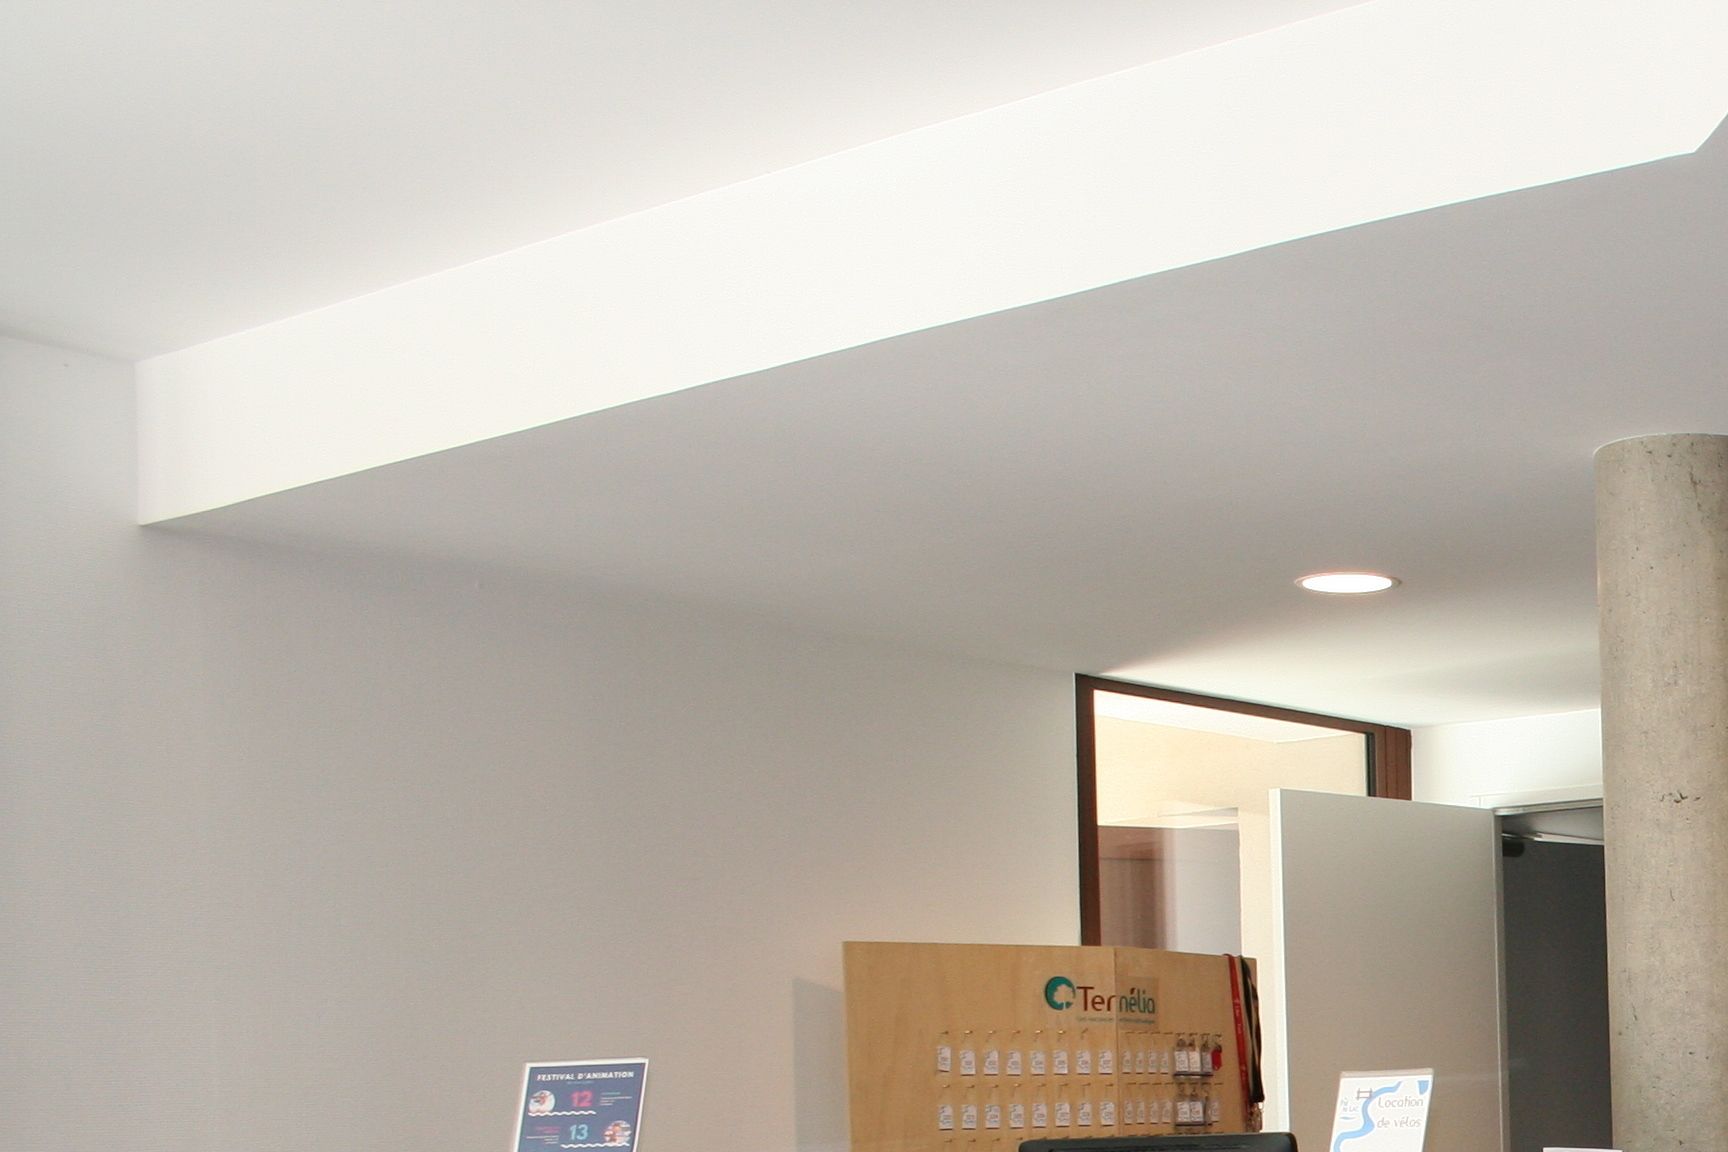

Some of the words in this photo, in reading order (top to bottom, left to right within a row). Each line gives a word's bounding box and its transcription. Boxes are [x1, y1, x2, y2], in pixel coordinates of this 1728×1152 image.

[1076, 986, 1156, 1014] Ternélia
[537, 1073, 575, 1082] FESTIVAL
[577, 1071, 634, 1080] D'ANIMATION
[571, 1090, 593, 1108] 12
[1378, 1096, 1424, 1108] Location
[1377, 1117, 1390, 1128] de
[1394, 1117, 1421, 1128] vélos
[569, 1124, 589, 1140] 13
